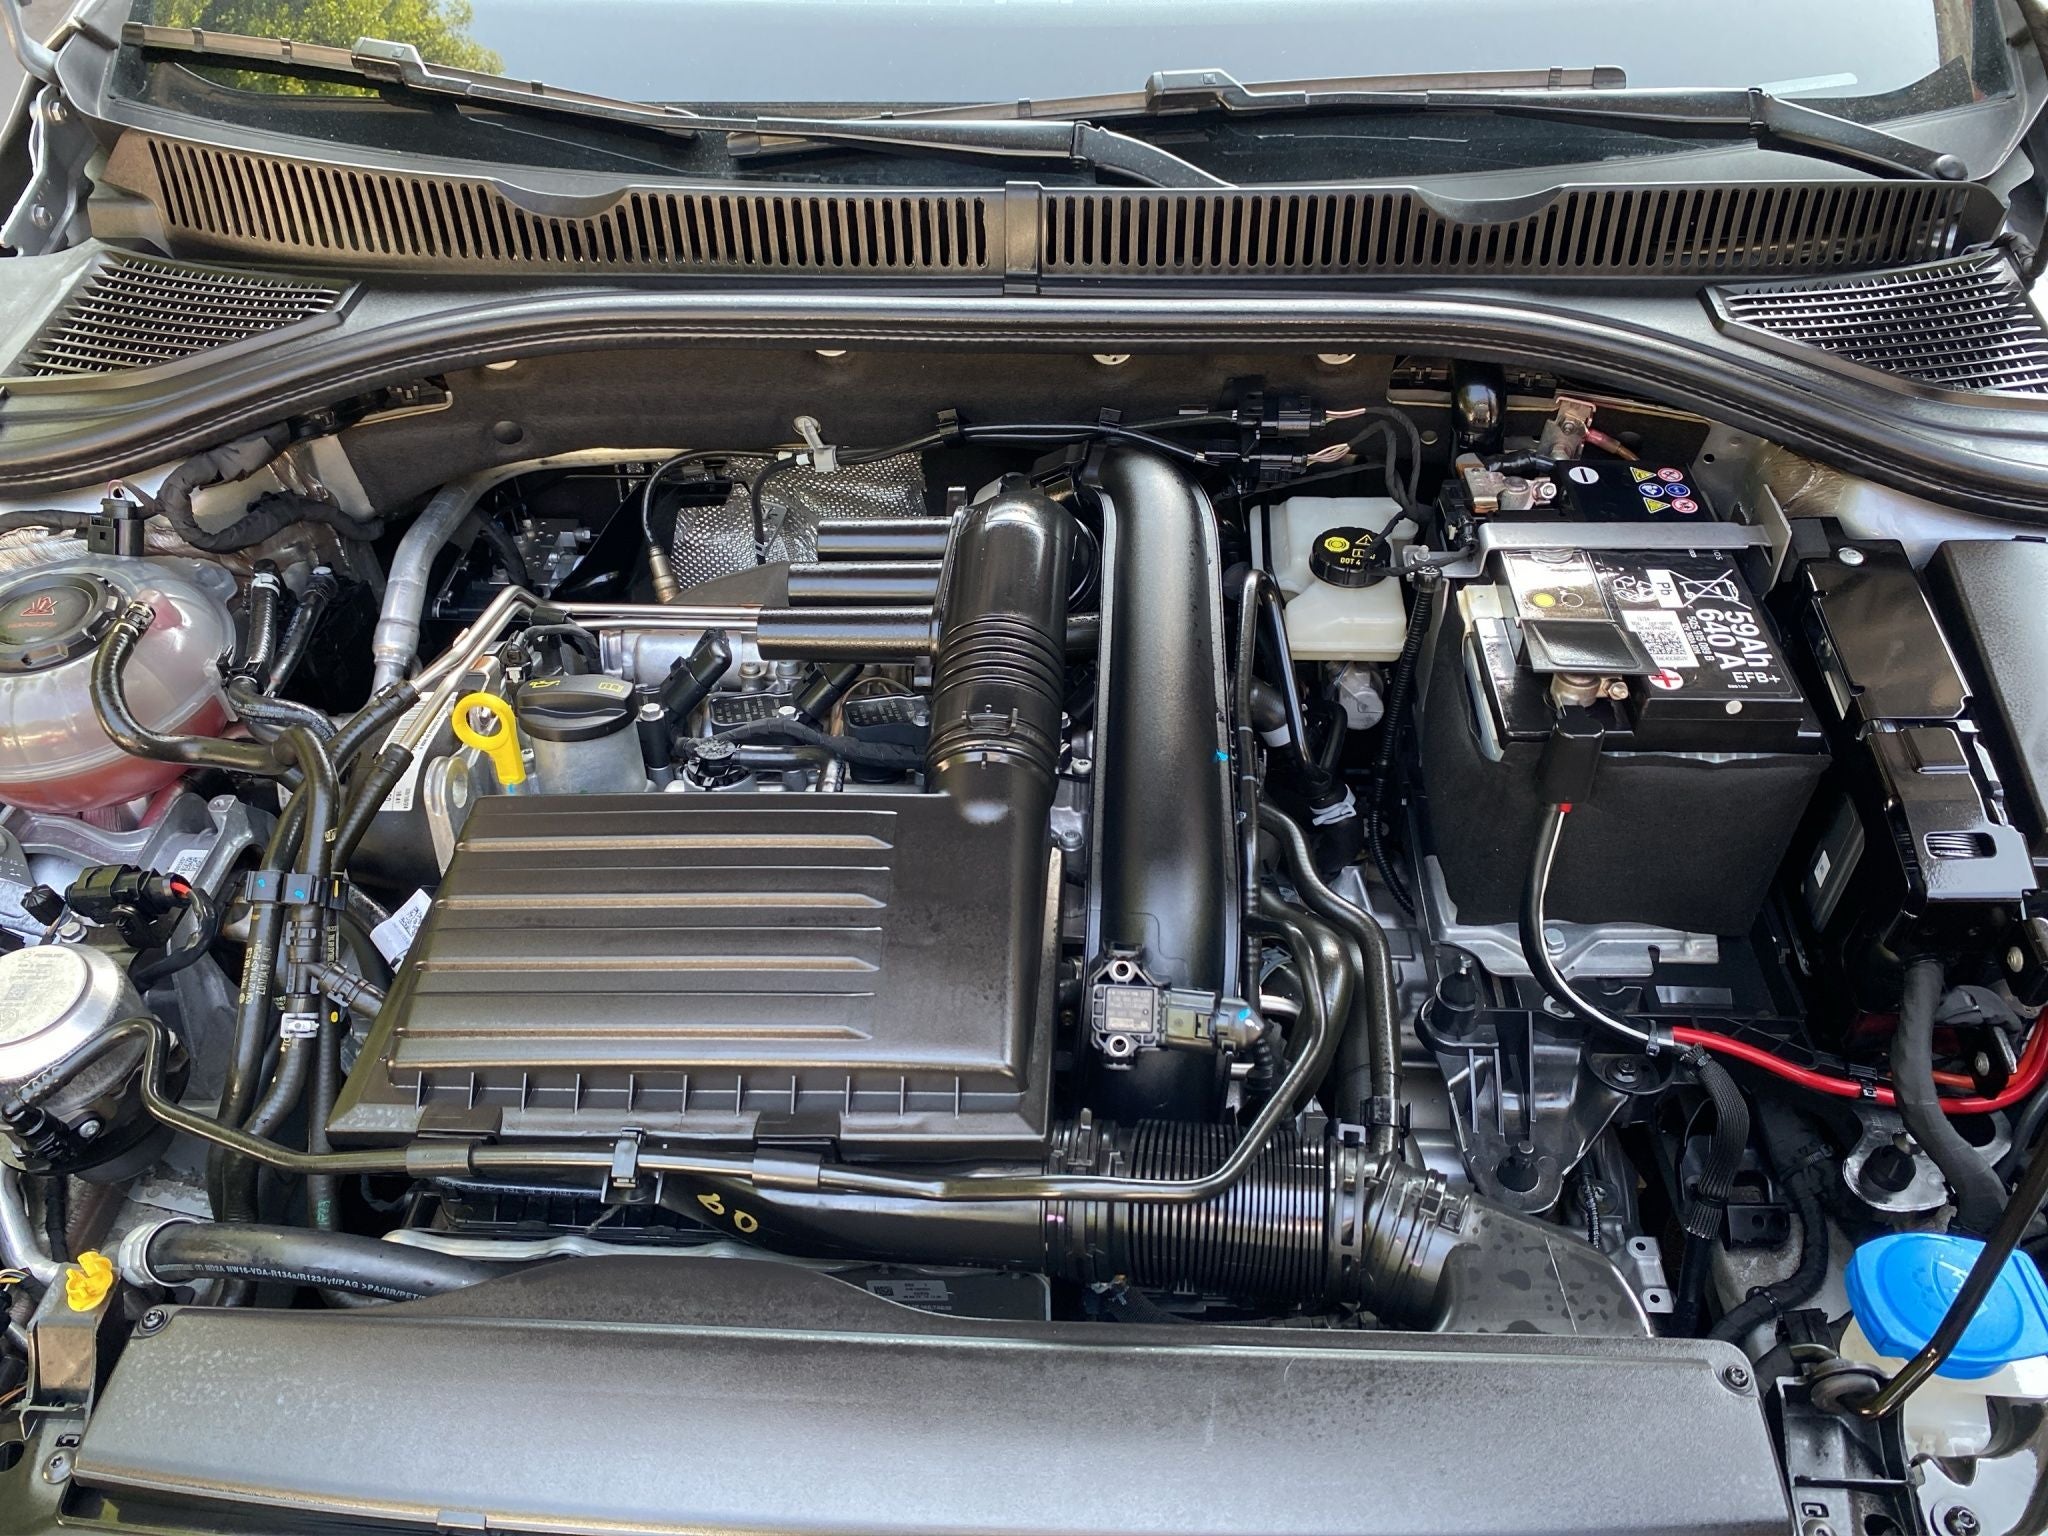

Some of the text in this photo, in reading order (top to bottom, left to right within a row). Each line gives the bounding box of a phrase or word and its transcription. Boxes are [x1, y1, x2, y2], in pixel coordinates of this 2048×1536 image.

[1657, 582, 1673, 596] Pb
[1696, 609, 1736, 647] 640
[1725, 610, 1773, 667] 59Ah
[1713, 651, 1746, 670] A
[1731, 671, 1781, 684] EFB+
